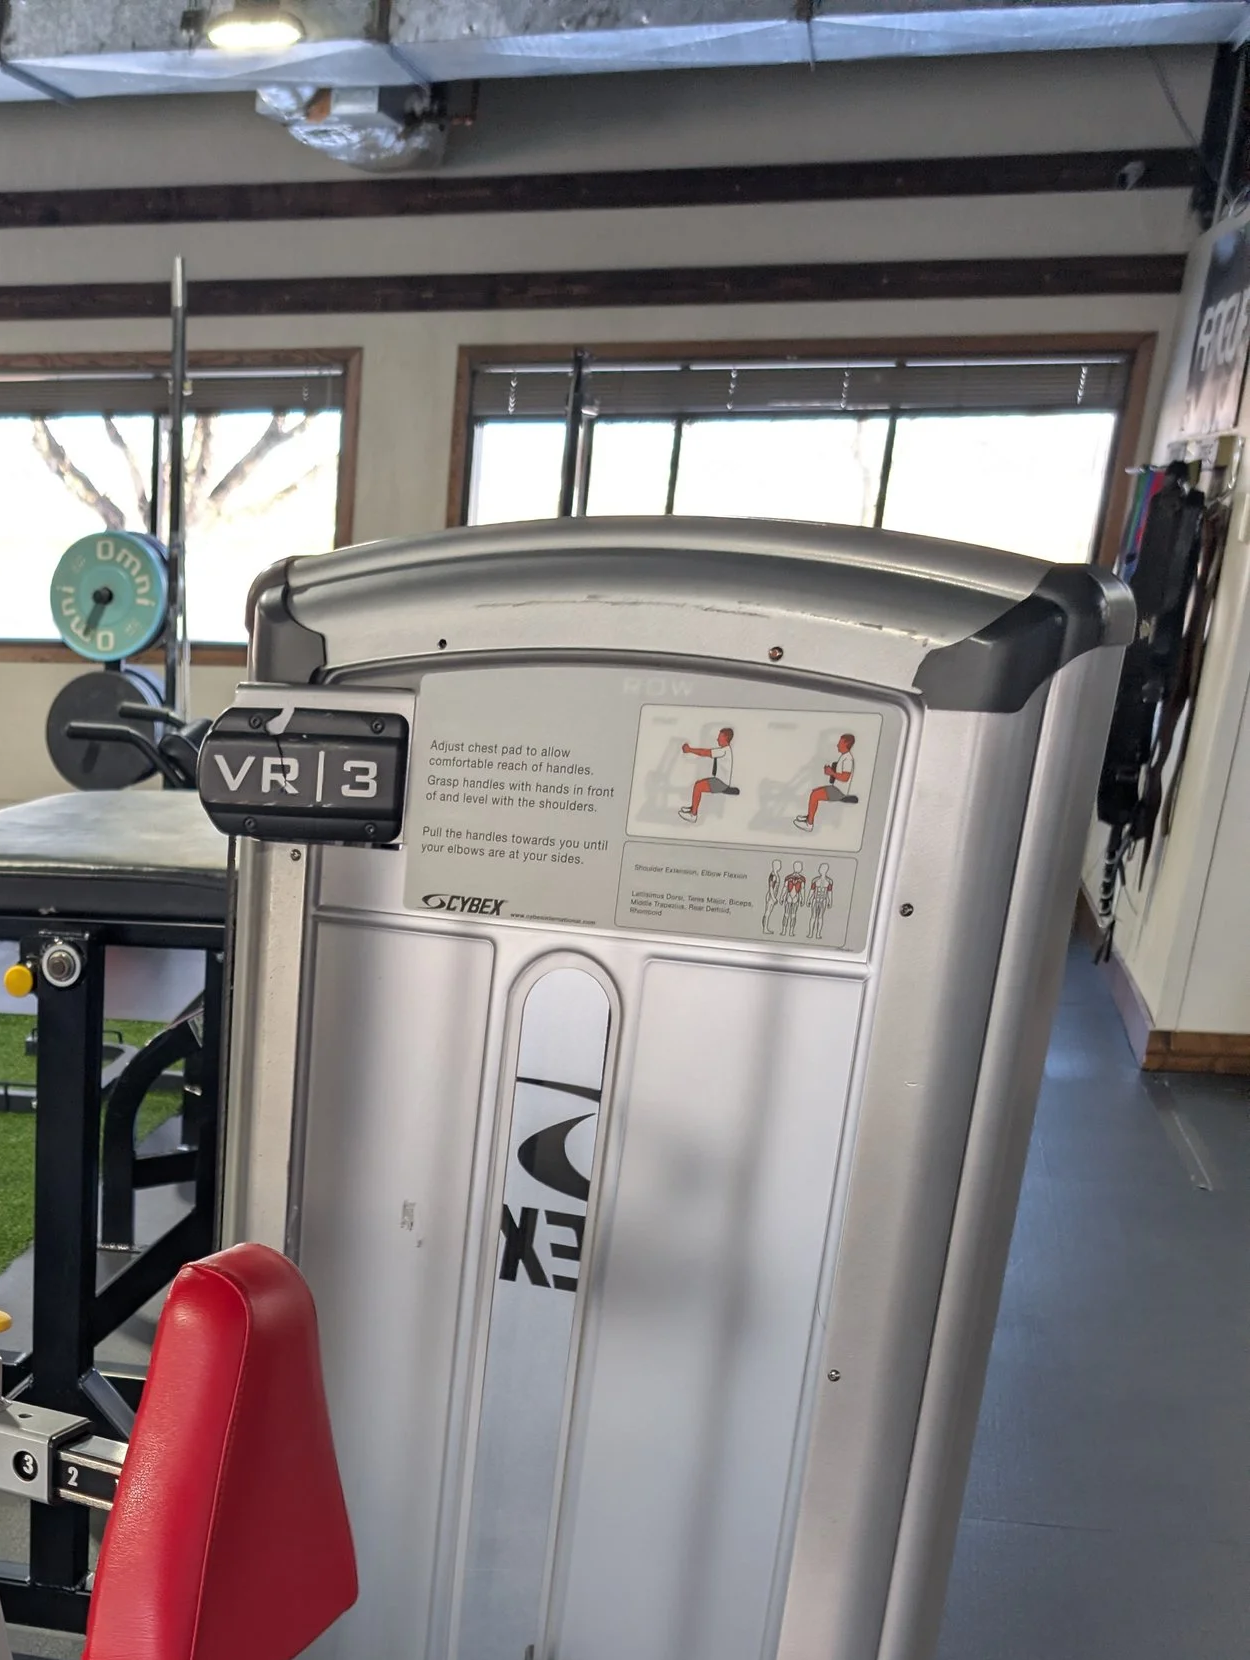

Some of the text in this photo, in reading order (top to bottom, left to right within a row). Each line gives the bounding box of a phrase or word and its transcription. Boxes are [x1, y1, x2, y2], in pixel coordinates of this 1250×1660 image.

[96, 540, 156, 608] Omni
[430, 740, 570, 758] Adjust chest pad to allow
[429, 757, 594, 776] comfortable reach of handles.
[427, 775, 614, 797] Grasp handles with hands in front
[425, 791, 597, 813] of and level with the shoulders.
[423, 826, 609, 850] Pull the handles towards you until
[421, 843, 584, 865] your elbows are at your sides.
[445, 895, 508, 916] CYBEX
[22, 1454, 34, 1474] 3
[67, 1466, 78, 1487] 2
